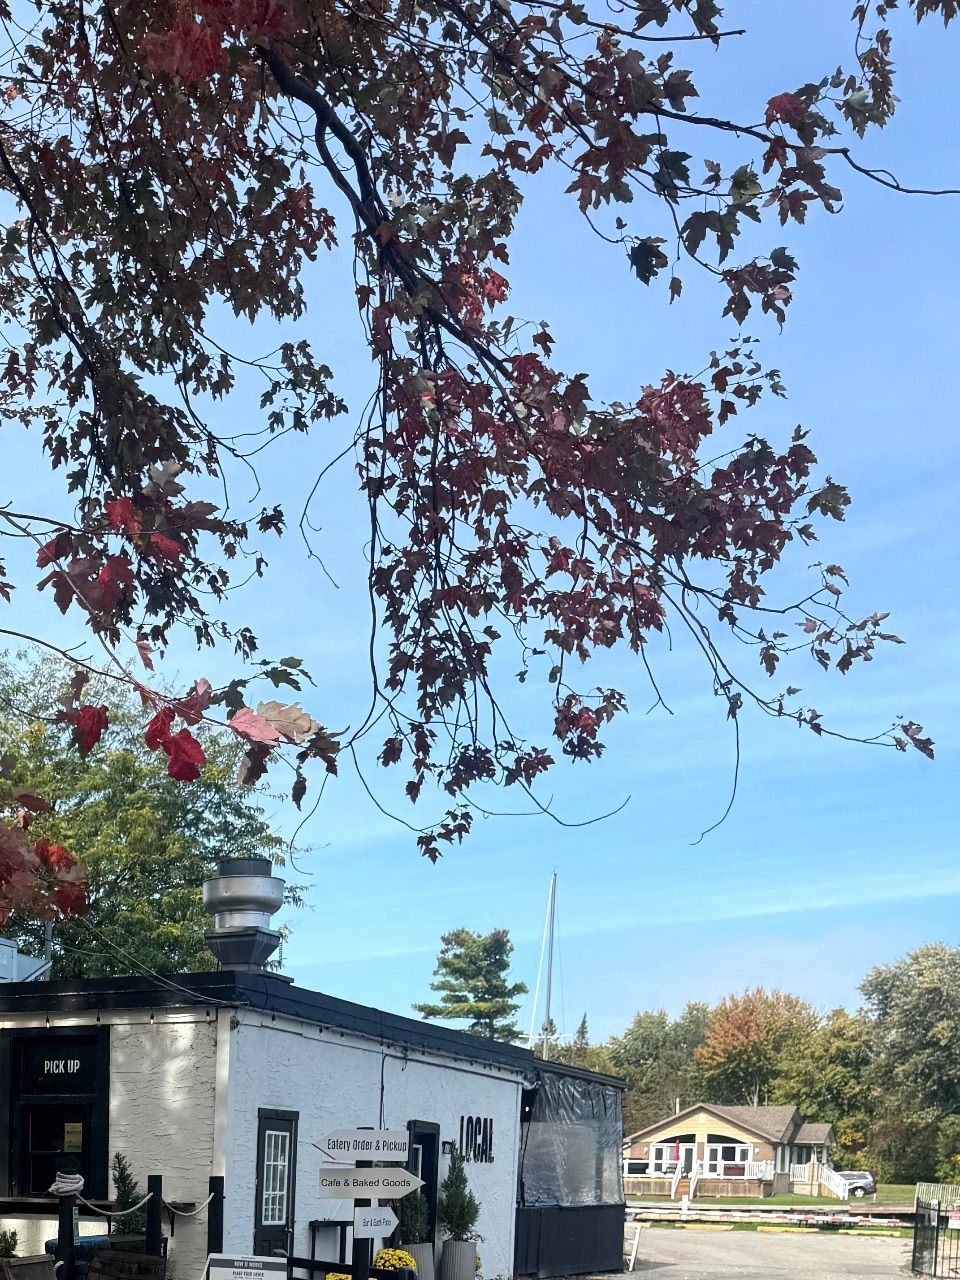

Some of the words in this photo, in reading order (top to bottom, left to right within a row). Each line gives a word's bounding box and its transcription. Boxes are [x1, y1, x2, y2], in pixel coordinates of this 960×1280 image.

[44, 1060, 65, 1074] PICK
[67, 1059, 81, 1073] UP
[327, 1139, 351, 1152] Eatery
[353, 1139, 373, 1151] Order
[375, 1140, 381, 1151] &
[382, 1140, 407, 1152] Pickup
[460, 1115, 495, 1163] LOCAL
[321, 1178, 341, 1187] Cafe
[343, 1178, 350, 1187] &
[352, 1178, 380, 1187] Baked
[382, 1179, 411, 1187] Goods
